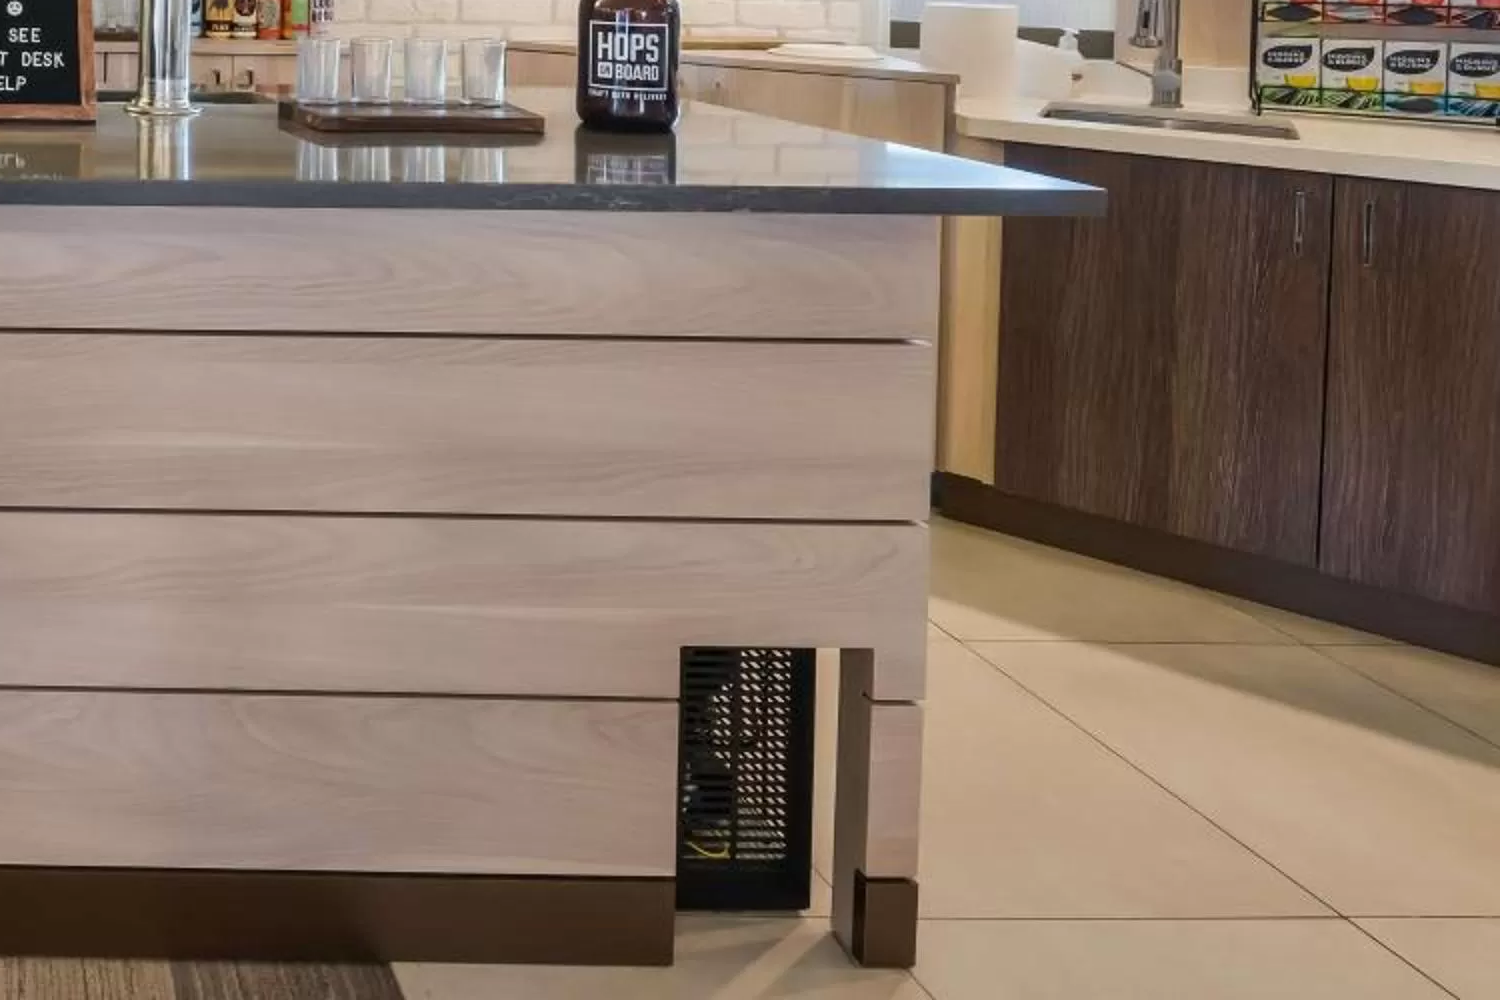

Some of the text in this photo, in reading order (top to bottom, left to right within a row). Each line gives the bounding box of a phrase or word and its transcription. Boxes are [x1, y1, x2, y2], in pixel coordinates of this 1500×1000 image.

[7, 28, 42, 44] SEE
[597, 31, 660, 63] HOPS
[21, 52, 66, 69] DESK
[615, 63, 659, 81] BOARD
